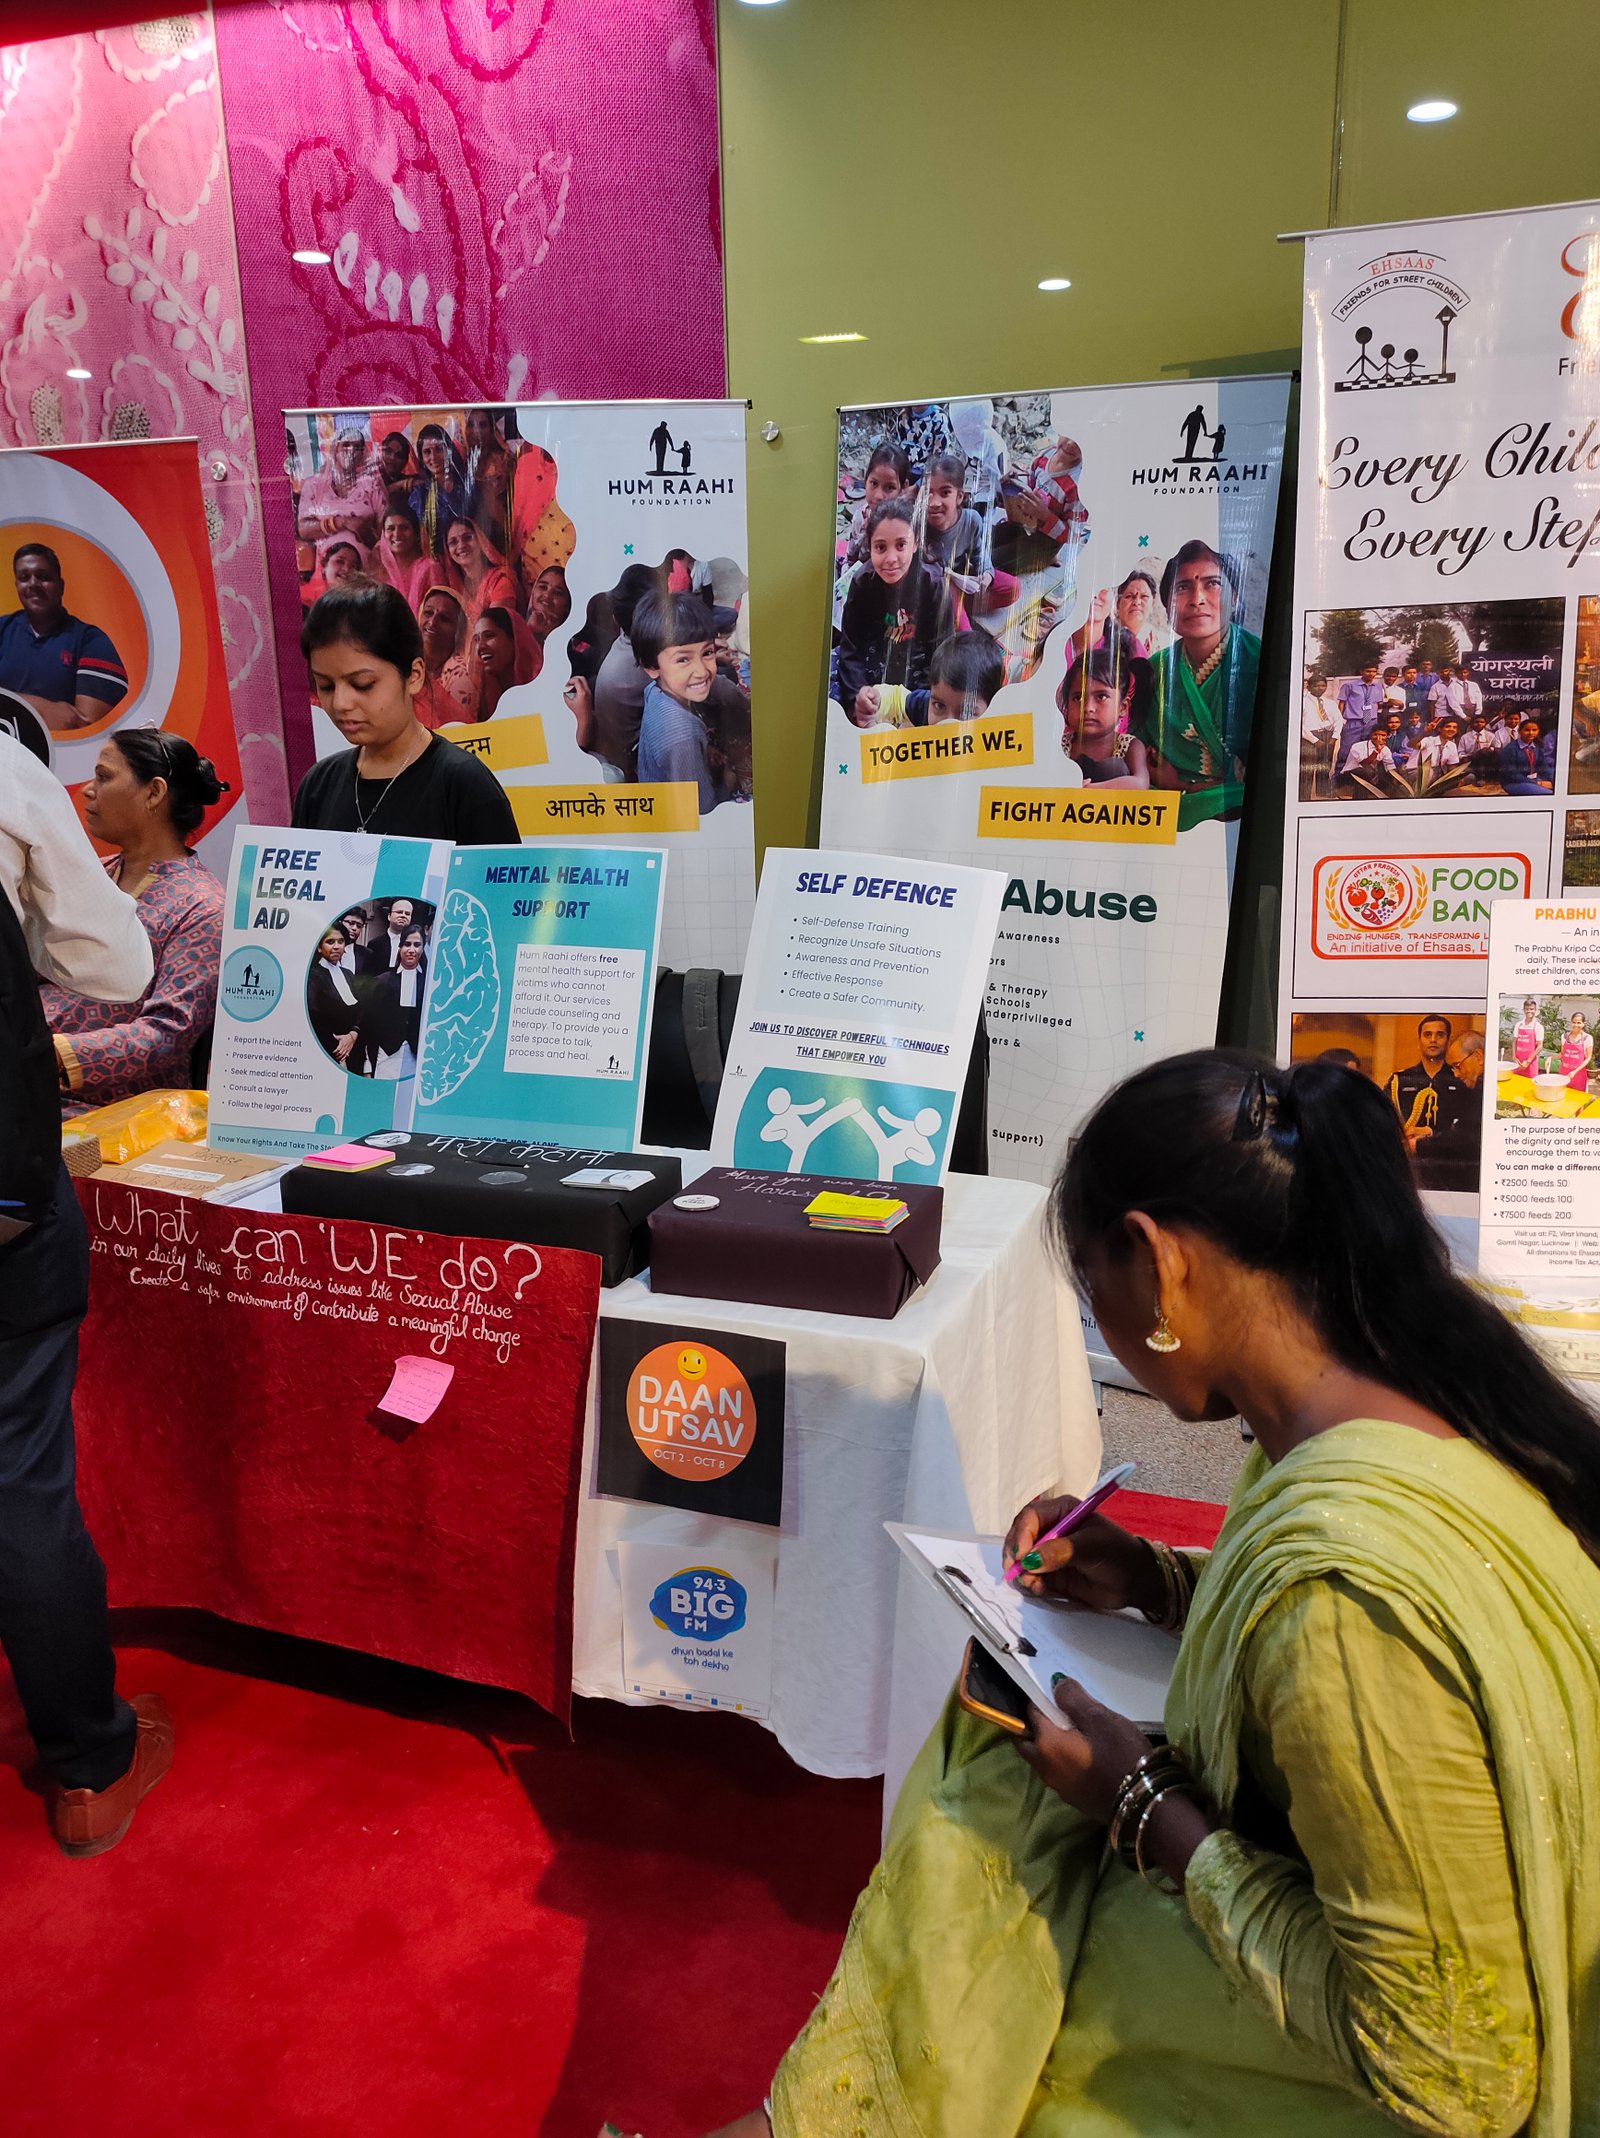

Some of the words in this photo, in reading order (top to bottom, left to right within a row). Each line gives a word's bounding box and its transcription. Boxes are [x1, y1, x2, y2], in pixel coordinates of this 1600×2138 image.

[1370, 257, 1435, 276] EHSAAS
[1340, 286, 1371, 316] FRIENDS
[1373, 278, 1390, 290] FOR
[1393, 275, 1425, 285] STREET
[1426, 278, 1463, 305] CHILDREN
[1132, 467, 1178, 485] HUM
[1189, 464, 1269, 482] RAAHI
[1318, 436, 1469, 503] Every
[608, 479, 653, 495] HUM
[663, 478, 734, 494] RAAHI
[1153, 486, 1240, 496] FOUNDATION
[1343, 508, 1495, 575] Every
[1470, 655, 1555, 673] योगस्थली
[870, 734, 974, 767] TOGETHER
[981, 729, 1023, 754] WE,
[545, 793, 606, 819] आपके
[614, 797, 655, 817] साथ
[990, 801, 1055, 822] FIGHT
[1062, 803, 1167, 826] AGAINST
[260, 848, 321, 871] FREE
[485, 866, 550, 884] MENTAL
[556, 866, 630, 887] HEALTH
[1353, 863, 1374, 878] UTTAR
[1373, 862, 1402, 878] PRADESH
[1431, 867, 1520, 892] FOOD
[255, 877, 326, 902] LEGAL
[795, 872, 847, 895] SELF
[852, 875, 958, 908] DEFENCE
[1000, 878, 1158, 923] Abuse
[253, 907, 290, 930] AID
[1535, 907, 1597, 920] PRABHU
[801, 915, 865, 930] Self-Defense
[867, 921, 910, 938] Training
[998, 930, 1060, 945] Awareness
[1327, 933, 1362, 941] ENDING
[1408, 932, 1480, 940] TRANSFORMING
[798, 933, 848, 950] Recognize
[850, 939, 886, 951] Unsafe
[888, 942, 942, 959] Situations
[1329, 942, 1348, 953] An
[1350, 941, 1403, 952] initiative
[1406, 941, 1420, 952] of
[1423, 942, 1476, 954] Ehsaas,
[1514, 944, 1530, 953] The
[1532, 944, 1563, 953] Prabhu
[1564, 944, 1587, 954] Kripa
[542, 951, 569, 961] Raahi
[571, 952, 597, 963] offers
[599, 954, 619, 964] free
[794, 952, 848, 966] Awareness
[850, 956, 870, 968] and
[873, 959, 929, 975] Prevention
[1551, 956, 1577, 964] These
[552, 966, 581, 976] health
[583, 969, 620, 979] support
[622, 969, 635, 979] for
[791, 970, 832, 983] Effective
[834, 973, 884, 988] Response
[1515, 967, 1540, 975] street
[1541, 967, 1578, 976] children,
[517, 979, 549, 988] victims
[550, 980, 570, 989] who
[572, 982, 605, 991] cannot
[1553, 978, 1570, 986] and
[1572, 978, 1587, 986] the
[246, 988, 275, 997] RAAHI
[515, 992, 542, 1001] afford
[554, 994, 571, 1003] Our
[573, 996, 611, 1006] services
[1002, 984, 1048, 1000] Therapy
[788, 988, 821, 1000] Create
[832, 991, 859, 1004] Safer
[860, 995, 926, 1013] Community.
[986, 995, 1031, 1009] Schools
[513, 1006, 547, 1016] include
[548, 1008, 599, 1021] counseling
[602, 1011, 621, 1020] and
[564, 1023, 600, 1033] provide
[602, 1026, 620, 1036] you
[233, 1035, 258, 1045] Report
[272, 1037, 302, 1047] incident
[510, 1034, 530, 1042] safe
[531, 1036, 561, 1047] space
[749, 1022, 768, 1034] JOIN
[796, 1026, 838, 1039] DISCOVER
[841, 1031, 887, 1045] POWERFUL
[892, 1036, 950, 1054] TECHNIQUES
[232, 1052, 263, 1061] Preserve
[264, 1053, 298, 1063] evidence
[508, 1048, 545, 1058] process
[546, 1050, 565, 1059] and
[567, 1051, 590, 1061] heal.
[796, 1046, 819, 1058] THAT
[821, 1049, 866, 1063] EMPOWER
[868, 1054, 887, 1066] YOU
[230, 1068, 248, 1076] Seek
[249, 1069, 279, 1078] medical
[279, 1071, 313, 1081] attention
[229, 1083, 257, 1092] Consult
[264, 1085, 289, 1096] lawyer
[227, 1100, 250, 1109] Follow
[264, 1102, 283, 1112] legal
[1511, 1125, 1527, 1134] The
[1528, 1126, 1565, 1135] purpose
[1521, 1137, 1551, 1147] dignity
[1554, 1138, 1572, 1146] and
[1506, 1150, 1554, 1159] encourage
[1556, 1149, 1579, 1157] them
[1495, 1163, 1511, 1171] You
[1531, 1163, 1555, 1171] make
[1501, 1178, 1528, 1187] ₹2500
[1530, 1179, 1555, 1188] feeds
[1556, 1179, 1568, 1188] 50
[1500, 1194, 1528, 1203] ₹5000
[1531, 1195, 1555, 1204] feeds
[1500, 1210, 1526, 1219] ₹7500
[1528, 1211, 1552, 1220] feeds
[96, 1186, 199, 1245] What
[221, 1226, 307, 1265] can
[319, 1222, 425, 1280] 'WE'
[89, 1235, 107, 1254] in
[113, 1243, 138, 1259] our
[145, 1242, 187, 1282] daily
[194, 1248, 222, 1276] lives
[236, 1258, 252, 1280] to
[262, 1268, 323, 1291] address
[328, 1277, 363, 1297] issues
[367, 1279, 393, 1301] like
[400, 1284, 460, 1311] Sexual
[462, 1291, 513, 1320] Abuse
[130, 1267, 170, 1288] Create
[227, 1290, 293, 1311] environment
[401, 1313, 468, 1355] meaningful
[472, 1319, 521, 1364] change
[639, 1375, 742, 1419] DAAN
[638, 1405, 745, 1448] UTSAV
[653, 1449, 677, 1460] OCT
[693, 1456, 717, 1467] OCT
[670, 1587, 735, 1620] BIG
[683, 1617, 708, 1632] FM
[671, 1646, 694, 1656] dhun
[696, 1647, 721, 1658] badal
[722, 1649, 734, 1658] ke
[684, 1656, 699, 1666] toh
[702, 1660, 730, 1671] dekho
